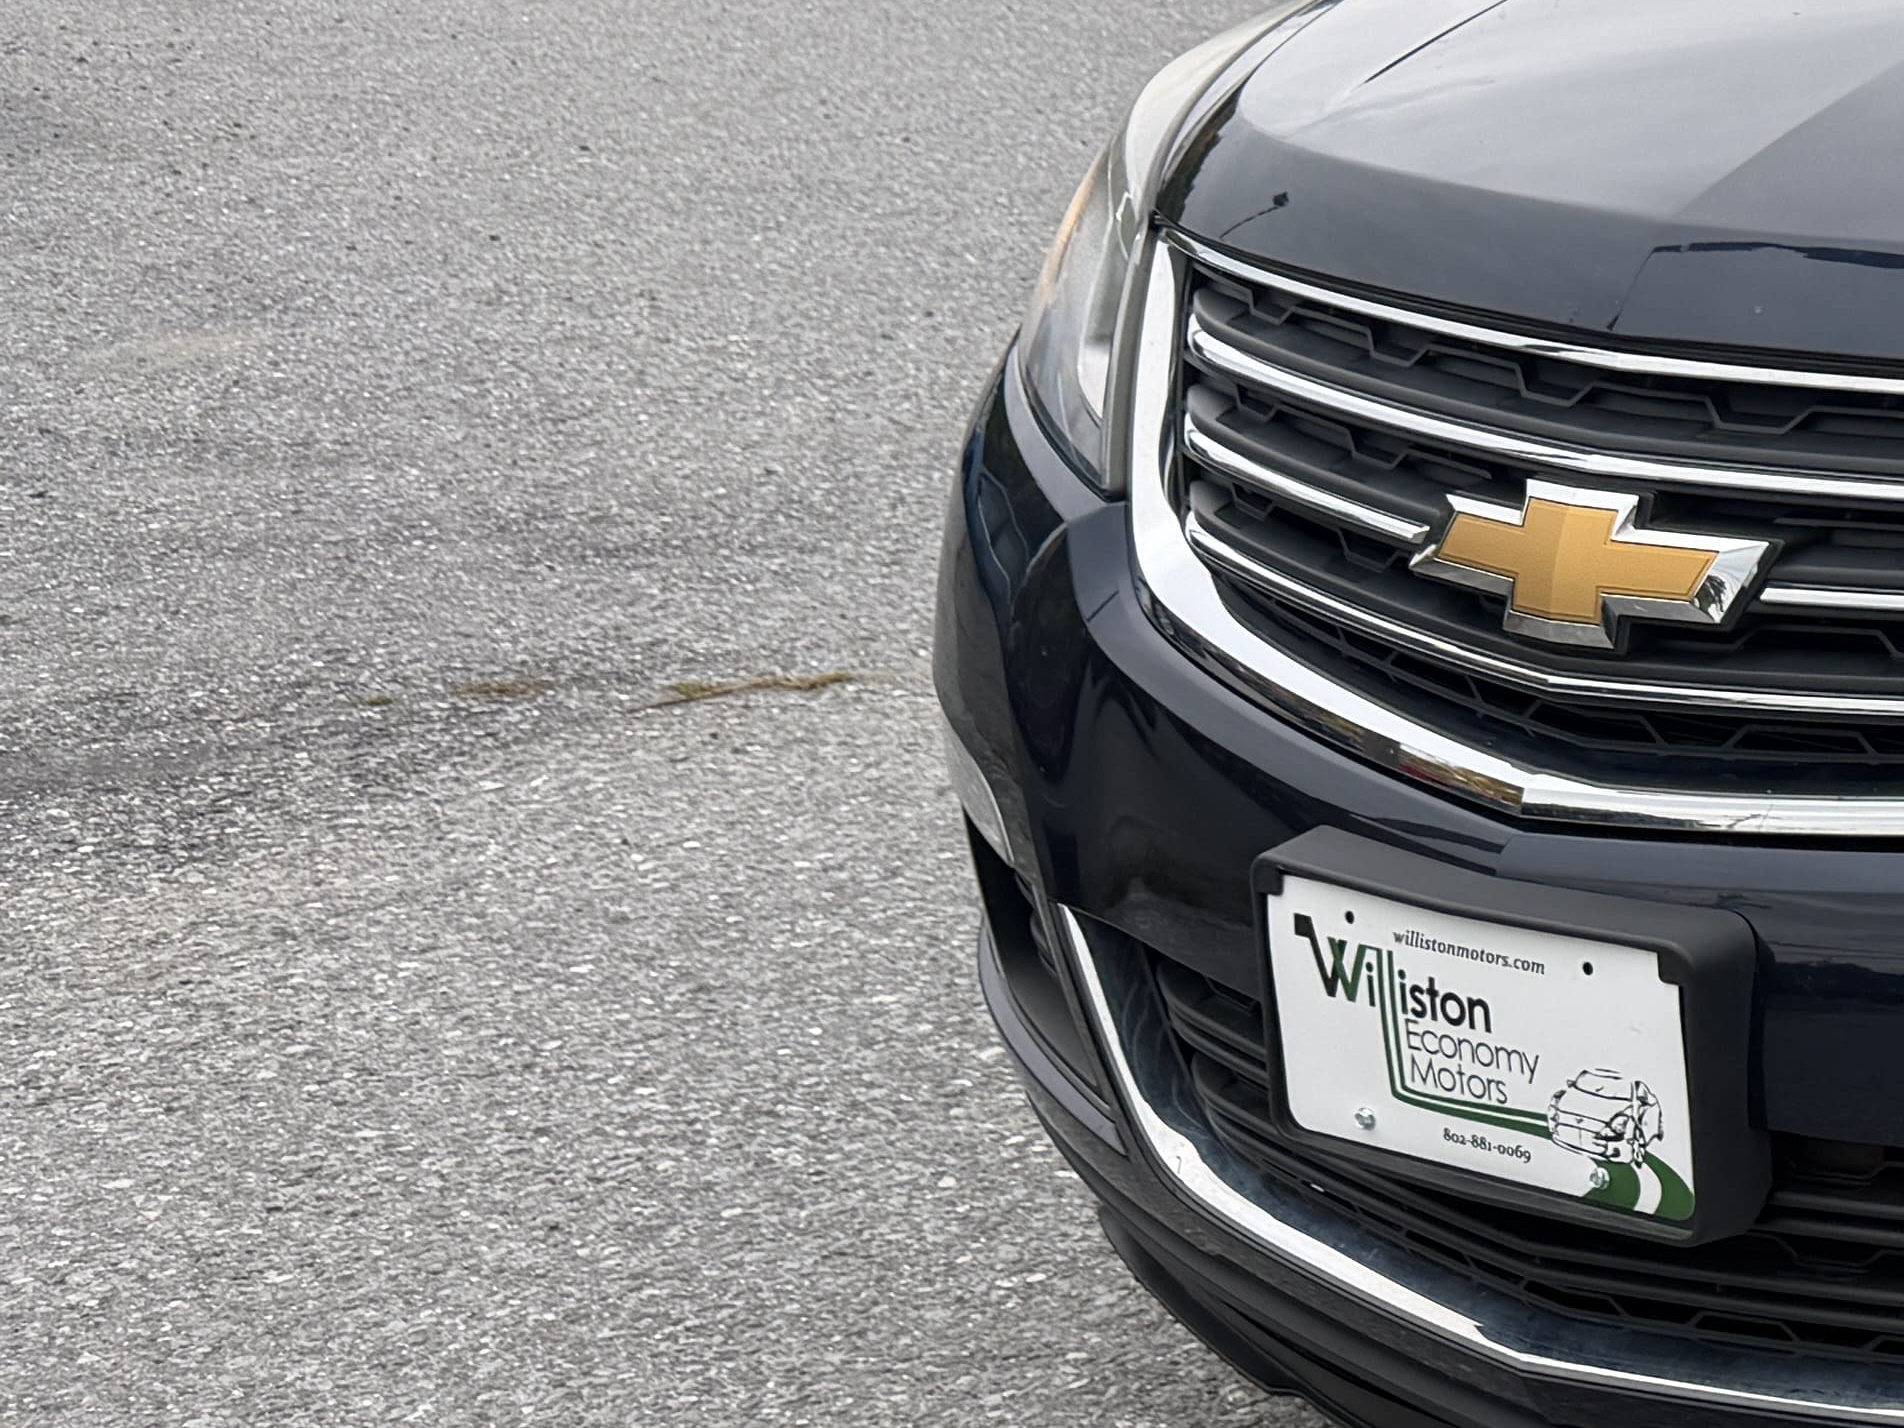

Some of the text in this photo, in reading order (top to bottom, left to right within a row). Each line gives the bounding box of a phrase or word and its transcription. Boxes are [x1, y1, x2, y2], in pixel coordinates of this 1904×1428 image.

[1293, 912, 1492, 1034] Williston
[1392, 929, 1546, 975] willistonmotors.com
[1404, 1018, 1540, 1085] Economy
[1410, 1053, 1508, 1104] Motors
[1442, 1127, 1532, 1164] 802-881-0069
